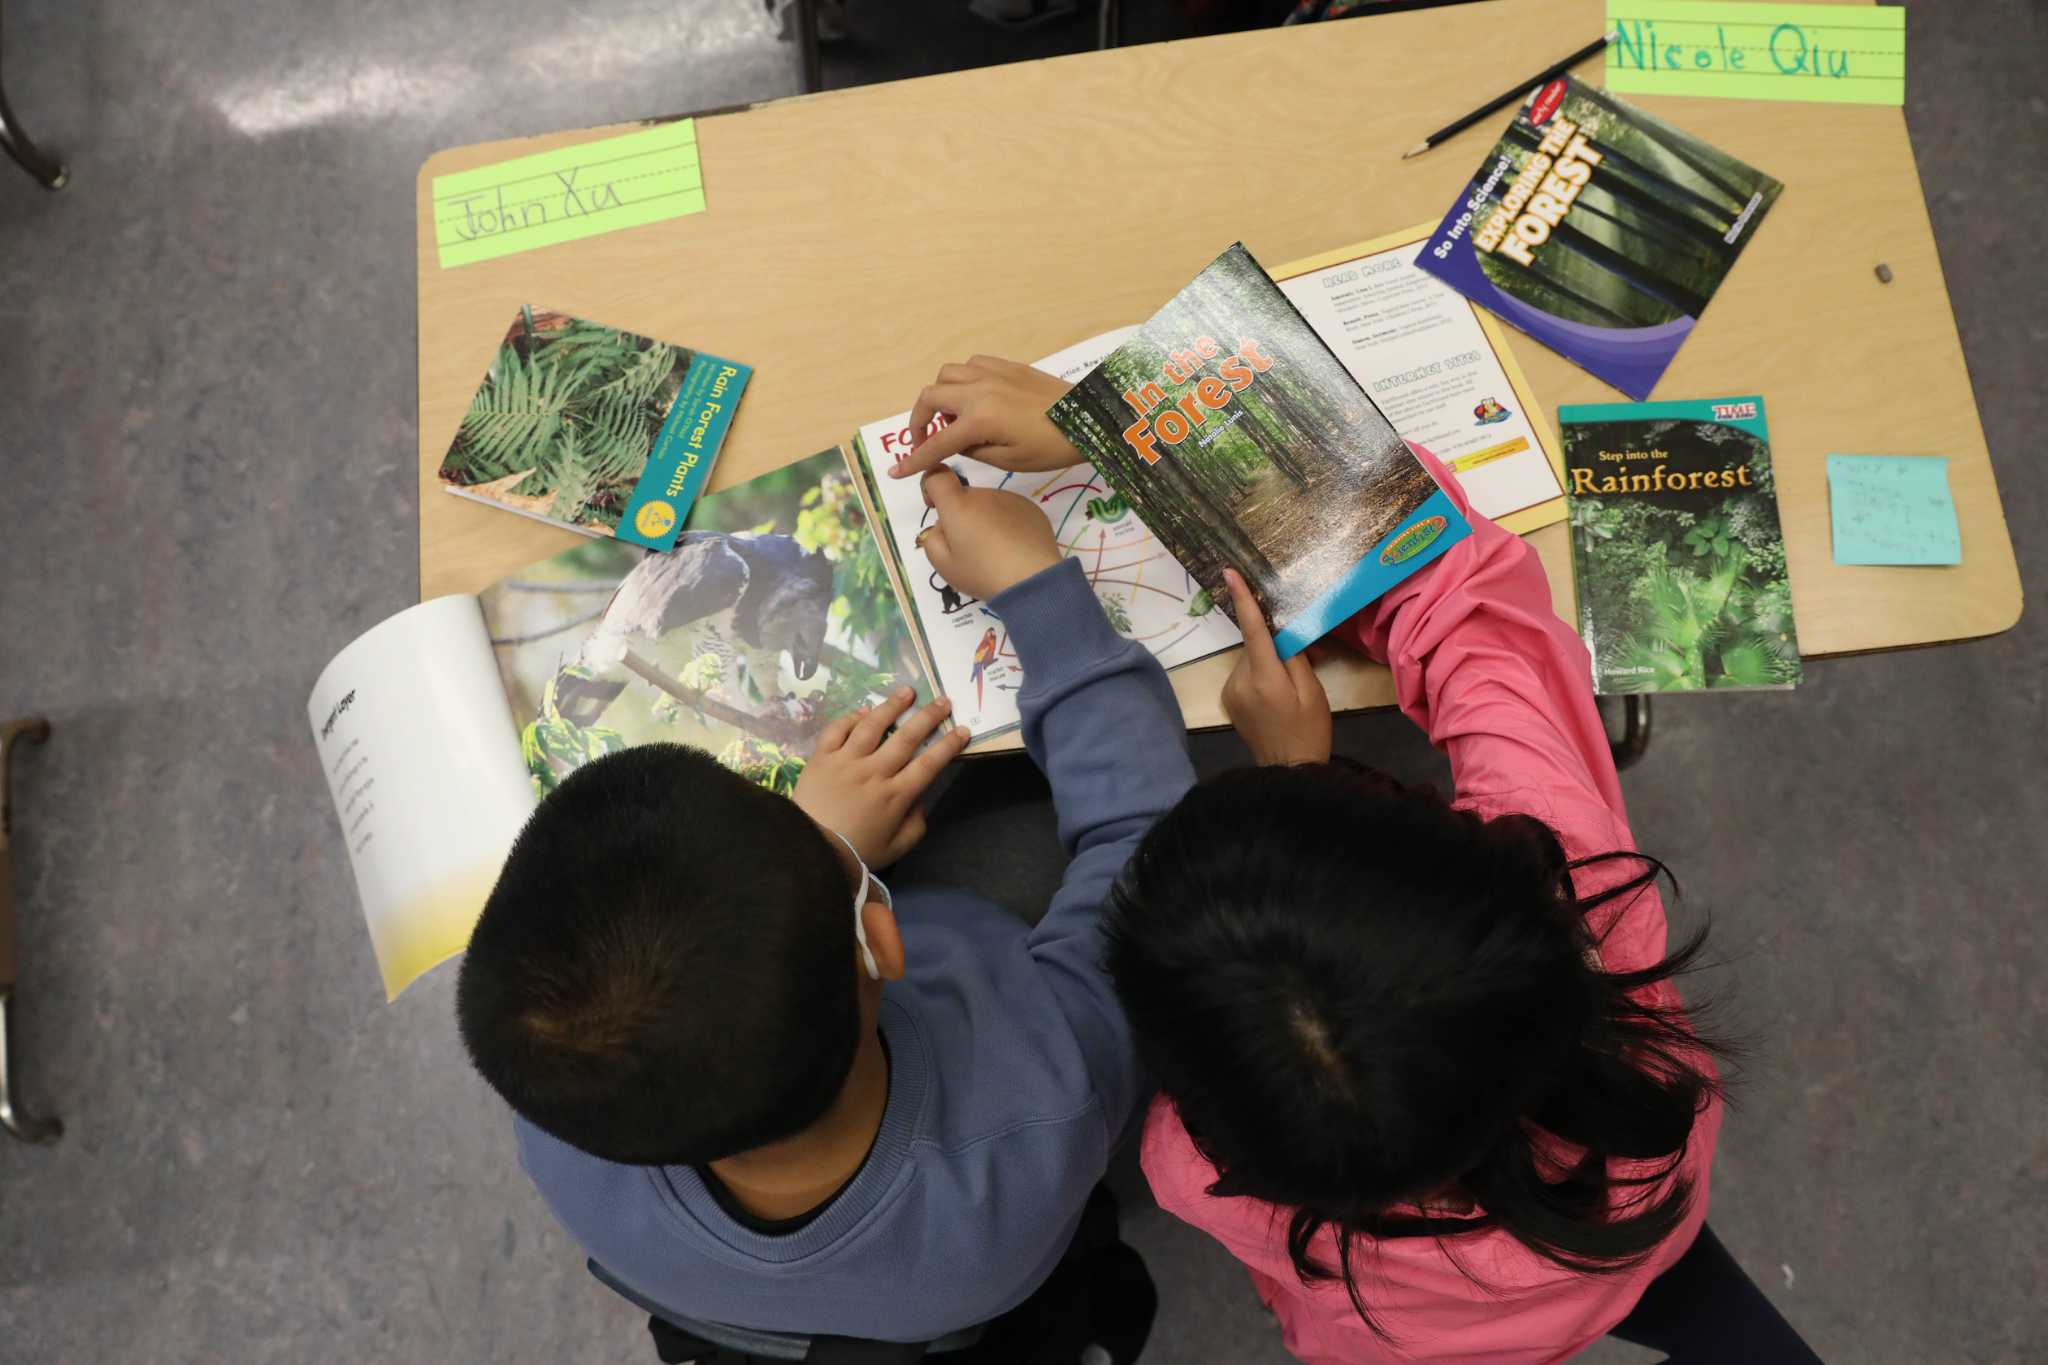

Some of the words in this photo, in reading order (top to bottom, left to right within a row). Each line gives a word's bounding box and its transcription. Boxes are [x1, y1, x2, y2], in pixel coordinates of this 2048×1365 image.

[1616, 18, 1745, 71] Nicole
[1769, 22, 1849, 78] Qiu
[448, 185, 548, 240] John
[554, 166, 624, 217] Xu
[1433, 240, 1453, 259] So
[1447, 212, 1472, 240] Into
[1467, 155, 1512, 212] Science!
[1472, 152, 1552, 253] EXPLORING
[1538, 116, 1579, 156] THE
[1499, 133, 1603, 267] FOREST
[710, 365, 737, 399] Rain
[1121, 381, 1168, 418] In
[1163, 336, 1218, 385] the
[1122, 336, 1274, 466] Forest
[688, 401, 722, 449] Forest
[1714, 405, 1756, 415] TIME
[666, 451, 699, 498] Plants
[1570, 464, 1752, 495] Rainforest
[1599, 451, 1623, 462] Step
[1626, 450, 1648, 460] into
[1650, 449, 1668, 459] the
